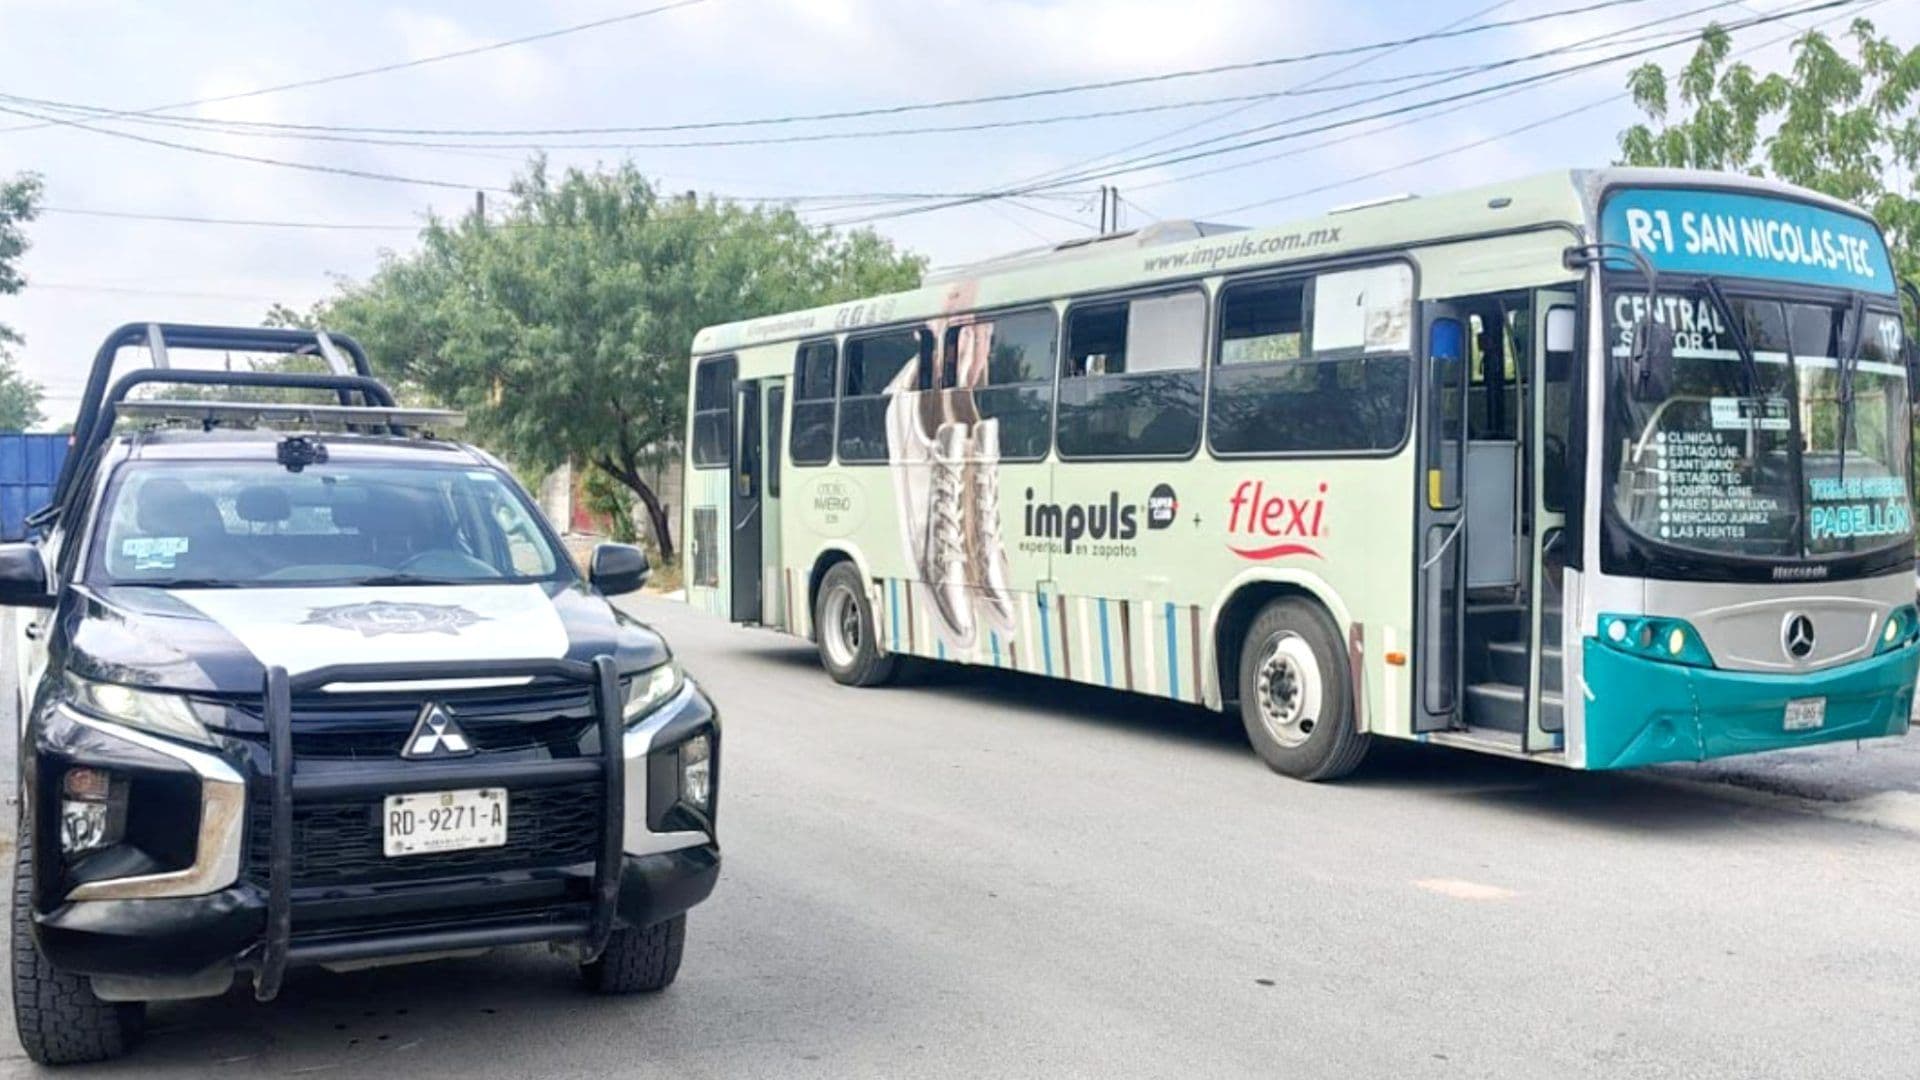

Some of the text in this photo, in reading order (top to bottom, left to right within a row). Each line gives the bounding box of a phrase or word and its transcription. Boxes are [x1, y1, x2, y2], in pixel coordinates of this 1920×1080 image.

[1144, 226, 1342, 272] www.impuls.com.mx
[1626, 208, 1875, 278] R-1 SAN NICOLAS-TEC
[1614, 295, 1725, 334] CENTRAL
[1620, 330, 1704, 350] SOR
[1668, 432, 1715, 445] CLINICA
[1669, 445, 1717, 458] ESTADIO
[1670, 459, 1734, 471] SANTUARIO
[1670, 472, 1742, 485] ESTADIO TEC
[1671, 485, 1725, 498] HOSPITAL
[1229, 481, 1328, 537] flexi
[1671, 499, 1709, 511] PASEO
[1025, 487, 1137, 554] impuls
[1672, 512, 1727, 525] MERCADO
[1672, 525, 1745, 538] LAS PUENTES
[1092, 543, 1137, 559] zapatos
[389, 803, 502, 836] RD-9271-A
